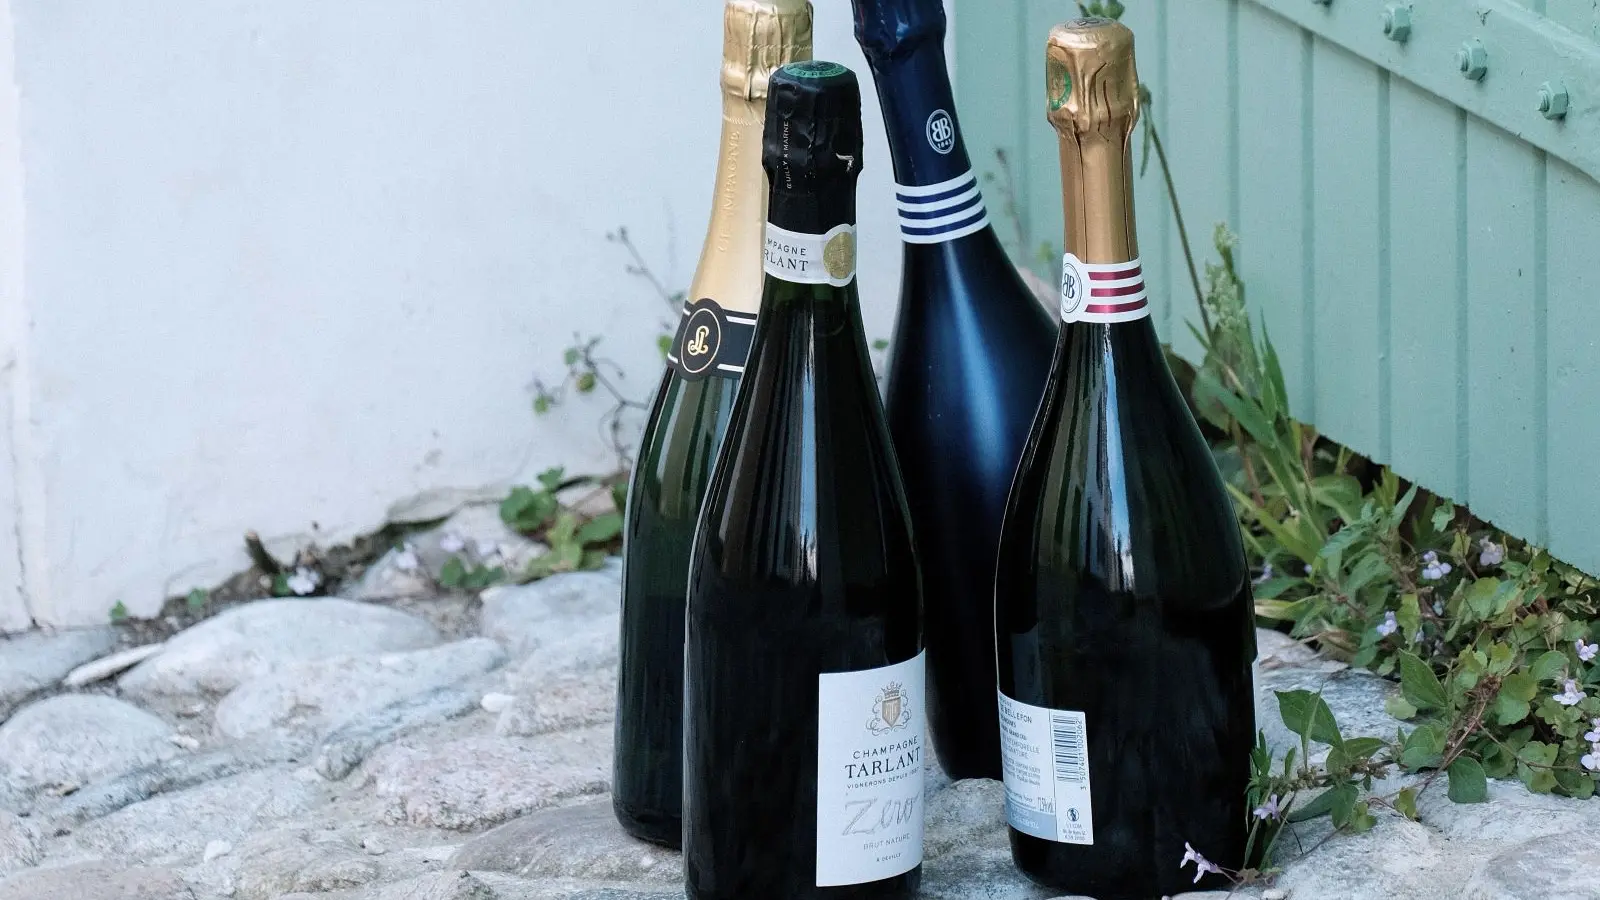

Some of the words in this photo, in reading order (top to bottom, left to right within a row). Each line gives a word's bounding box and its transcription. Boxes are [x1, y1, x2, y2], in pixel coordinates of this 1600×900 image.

[782, 121, 790, 151] MARNE
[764, 238, 807, 256] MPAGNE
[853, 735, 918, 759] CHAMPAGNE
[1075, 720, 1084, 749] 002062
[844, 746, 921, 779] TARLANT
[847, 779, 887, 790] VIGNERONS
[888, 773, 908, 783] DEPUIS
[841, 791, 920, 836] Zero
[863, 840, 884, 851] BRUT
[886, 832, 912, 846] NATURE
